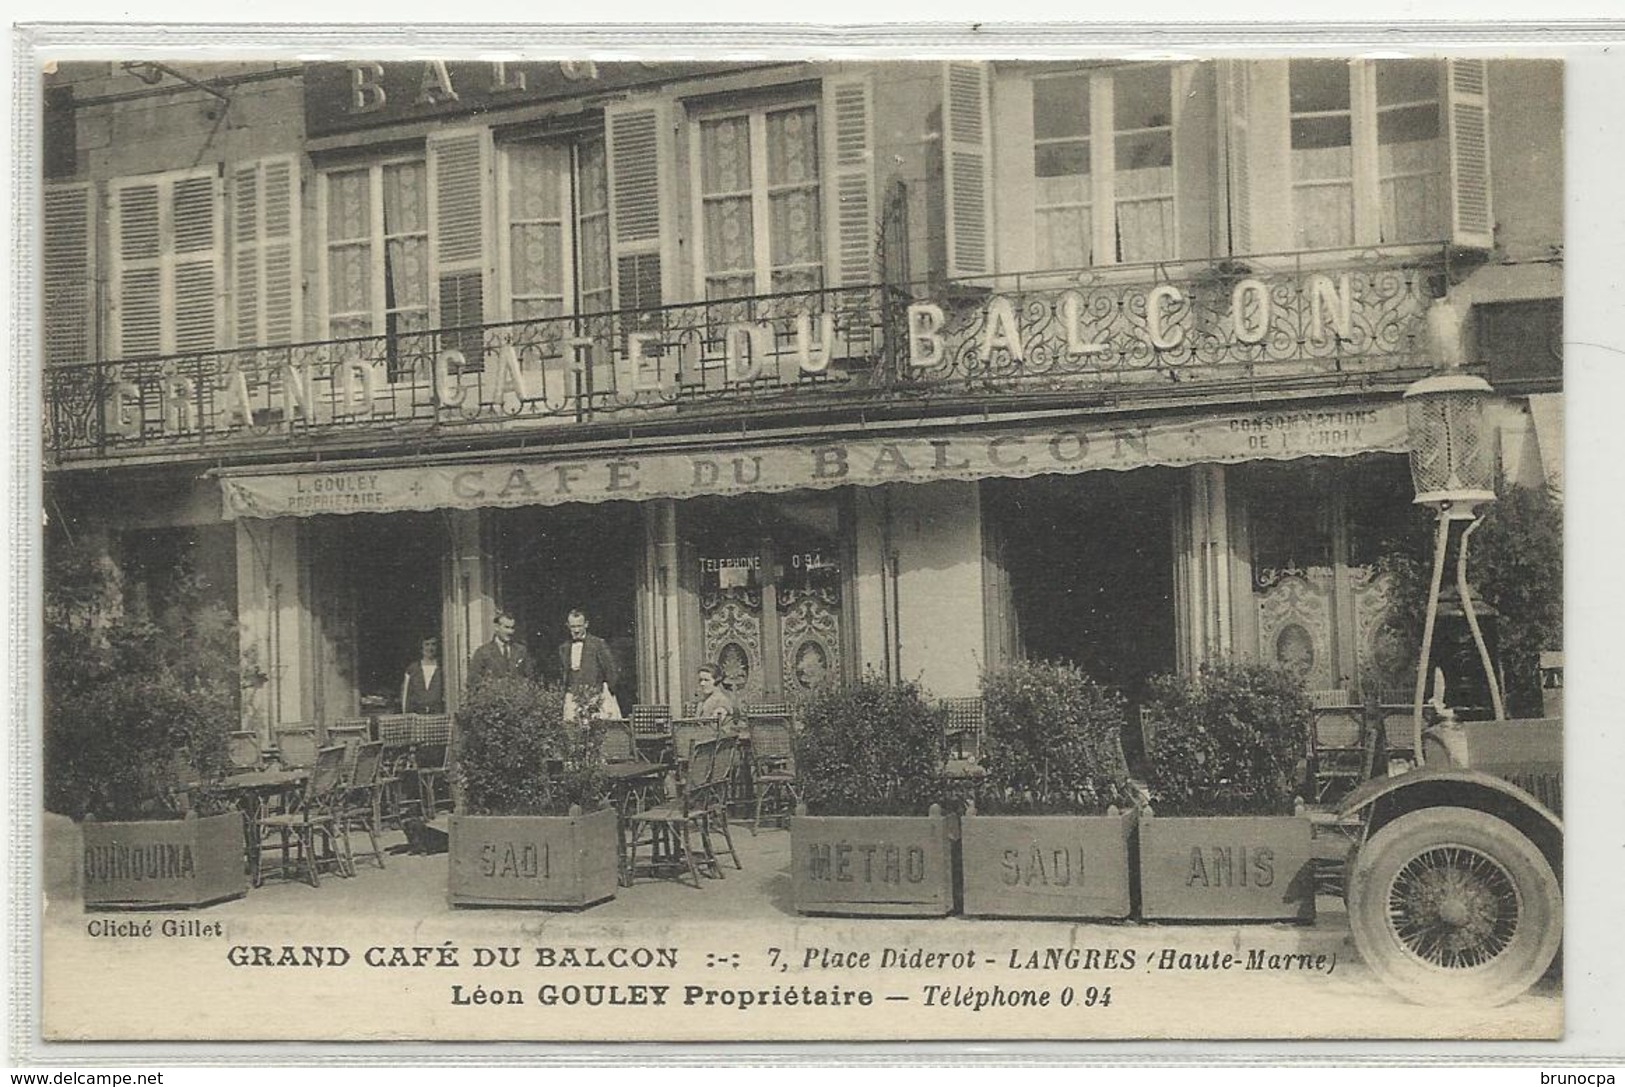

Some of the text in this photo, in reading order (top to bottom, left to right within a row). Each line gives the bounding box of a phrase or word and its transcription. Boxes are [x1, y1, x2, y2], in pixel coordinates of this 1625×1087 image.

[105, 356, 376, 437] GRAND
[726, 310, 833, 382] DU
[907, 275, 1352, 367] BALCON
[691, 456, 763, 489] DU
[811, 425, 1150, 480] BALCON
[1186, 845, 1275, 888] ANIS
